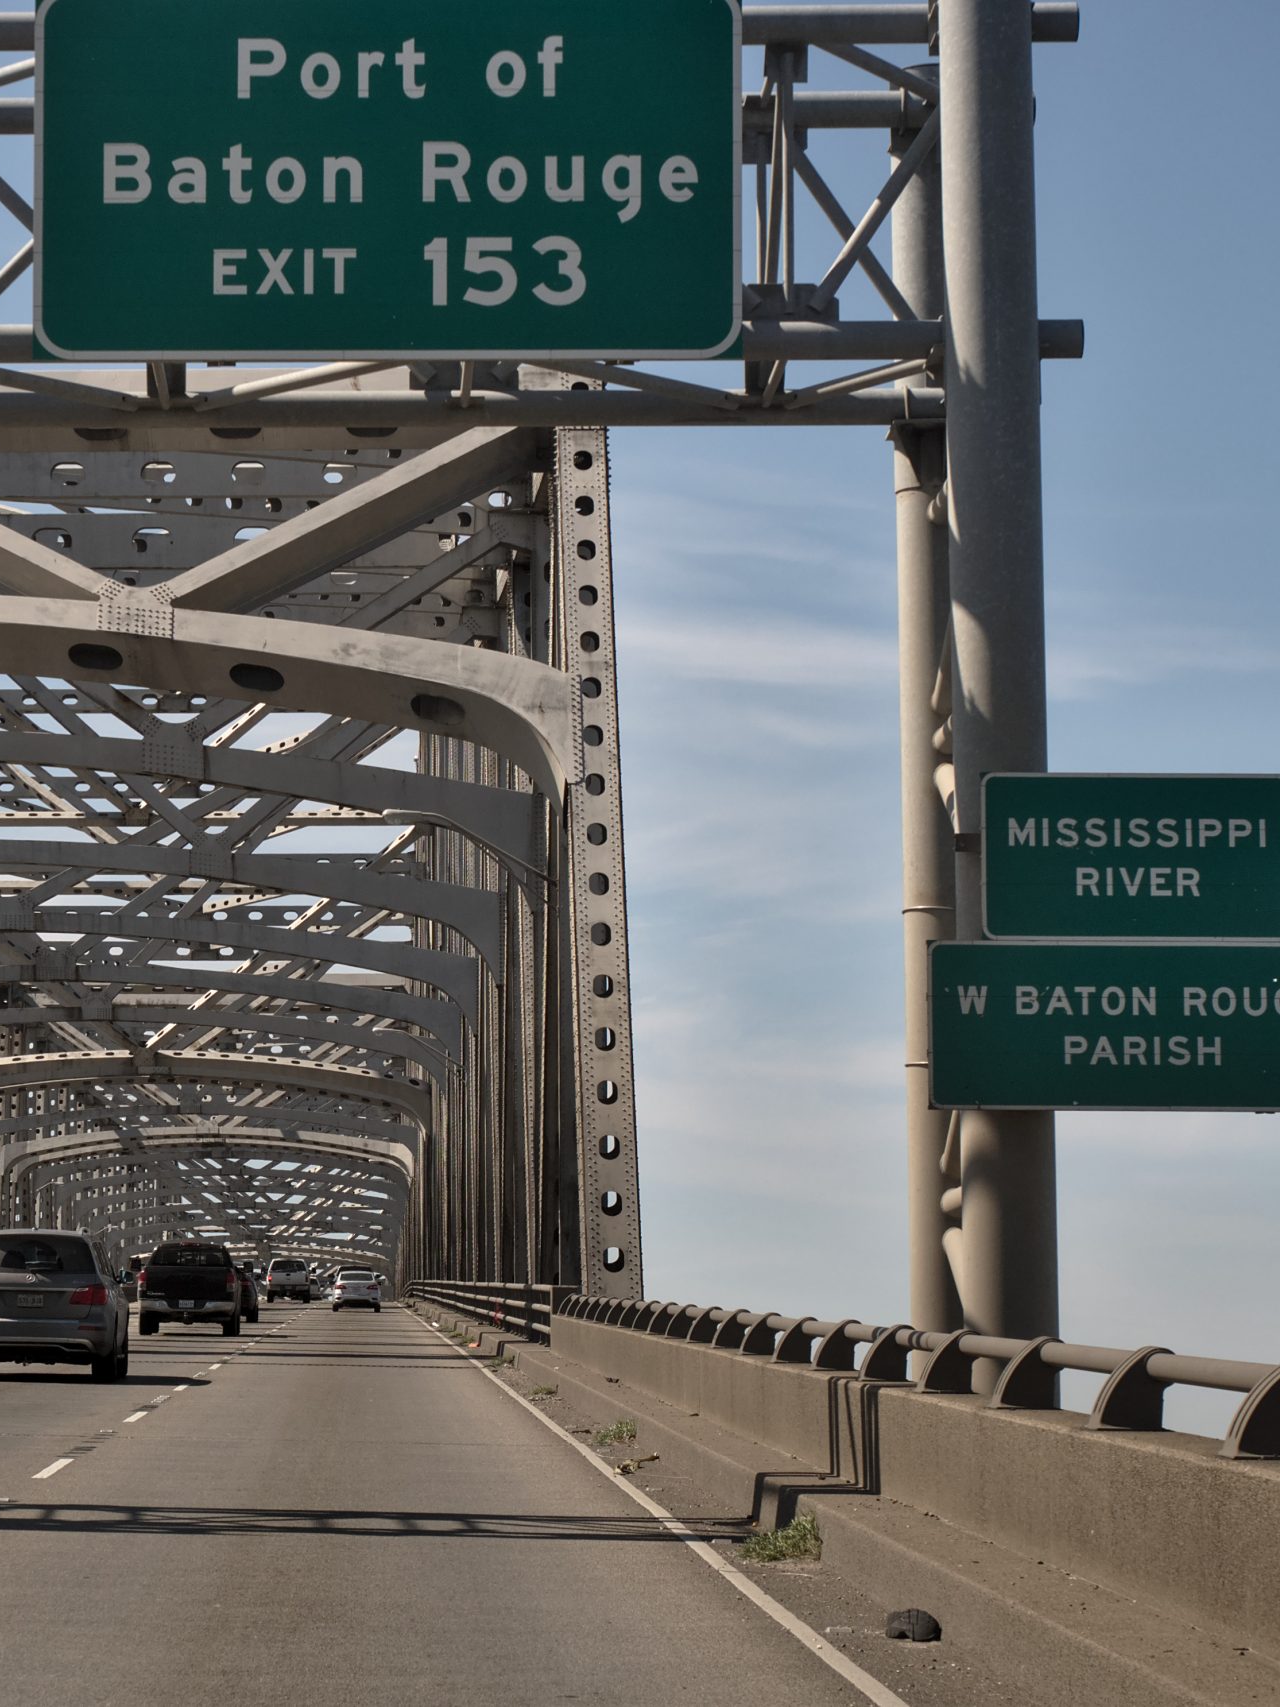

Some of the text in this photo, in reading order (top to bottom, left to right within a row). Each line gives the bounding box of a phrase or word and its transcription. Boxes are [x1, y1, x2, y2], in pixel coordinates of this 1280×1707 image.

[237, 35, 564, 99] Port of
[103, 140, 699, 224] Baton Rouge
[212, 235, 588, 307] EXIT 153
[1008, 817, 1267, 849] MISSISSIPPI
[1076, 866, 1201, 897] RIVER
[957, 985, 1280, 1017] W BATON ROU
[1064, 1035, 1223, 1066] PARISH
